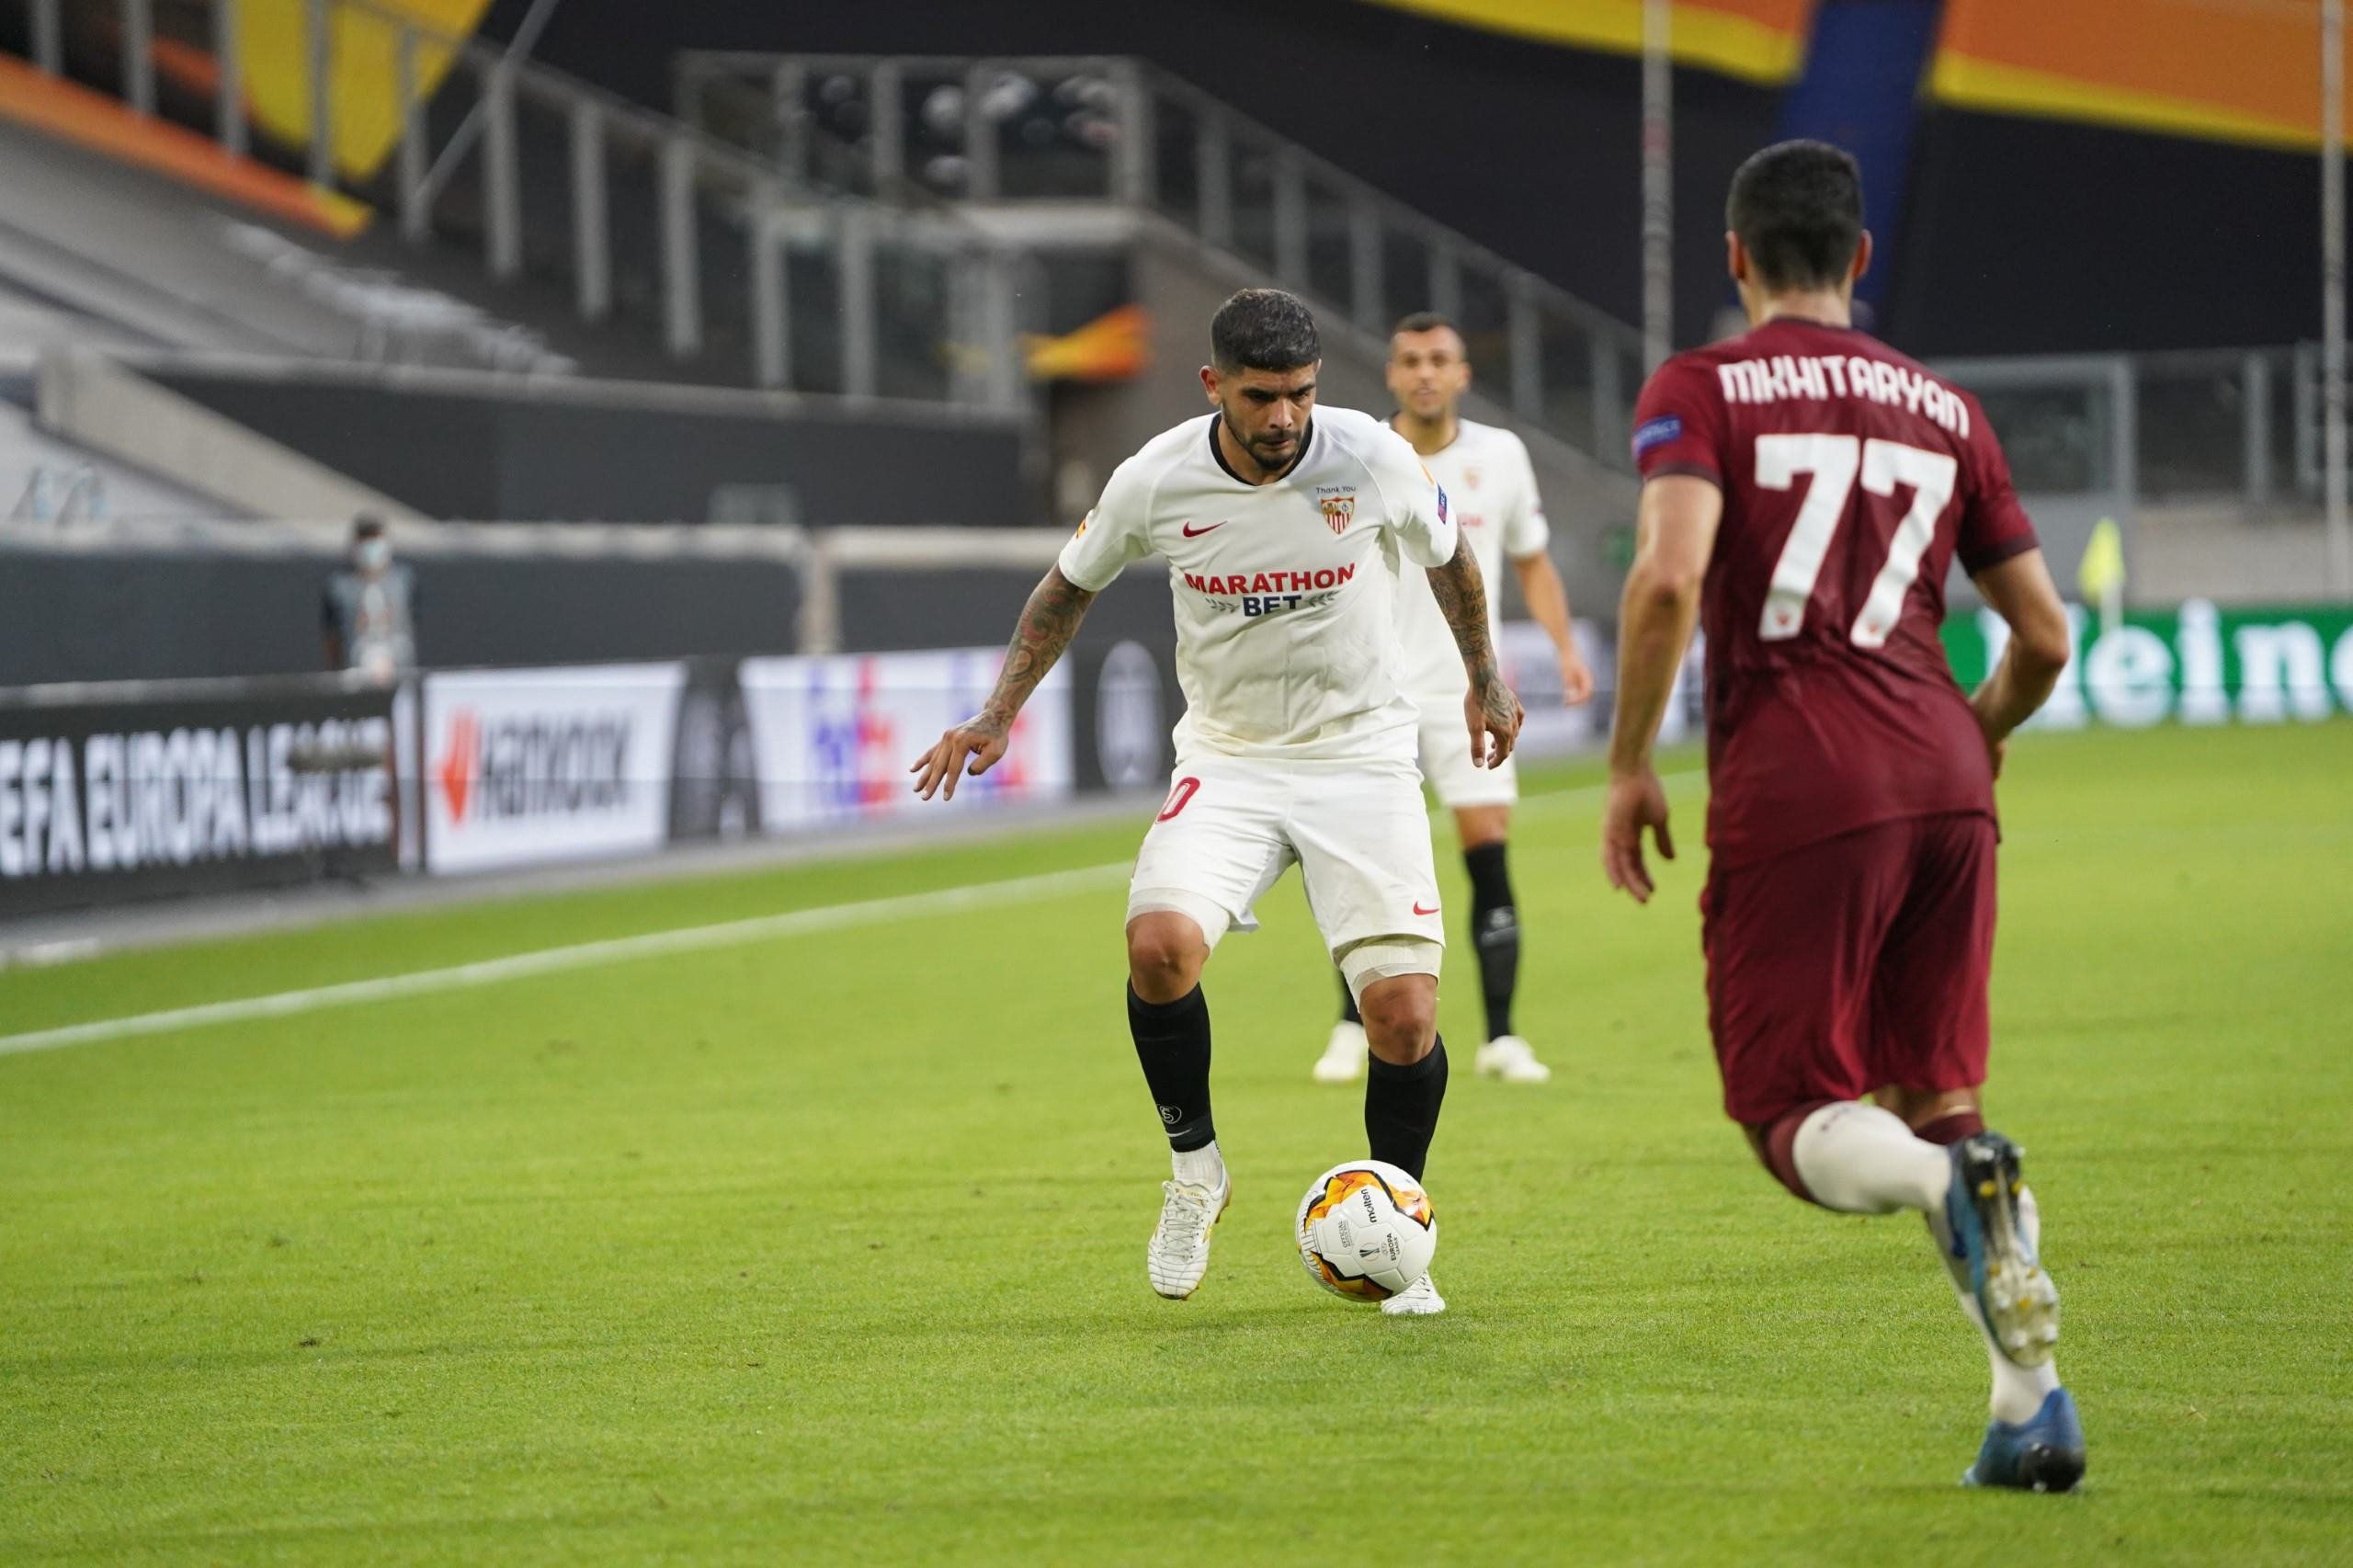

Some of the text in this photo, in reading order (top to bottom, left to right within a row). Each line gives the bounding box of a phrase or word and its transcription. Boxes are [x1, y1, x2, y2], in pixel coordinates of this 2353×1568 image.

[1718, 355, 1970, 440] MKHITARYAN
[1755, 434, 1958, 649] 77
[1183, 562, 1356, 596] MARATHON
[1243, 595, 1302, 617] BET
[85, 727, 248, 871] EUROPA
[1360, 1188, 1378, 1223] molten
[1386, 1233, 1397, 1261] EUROPA
